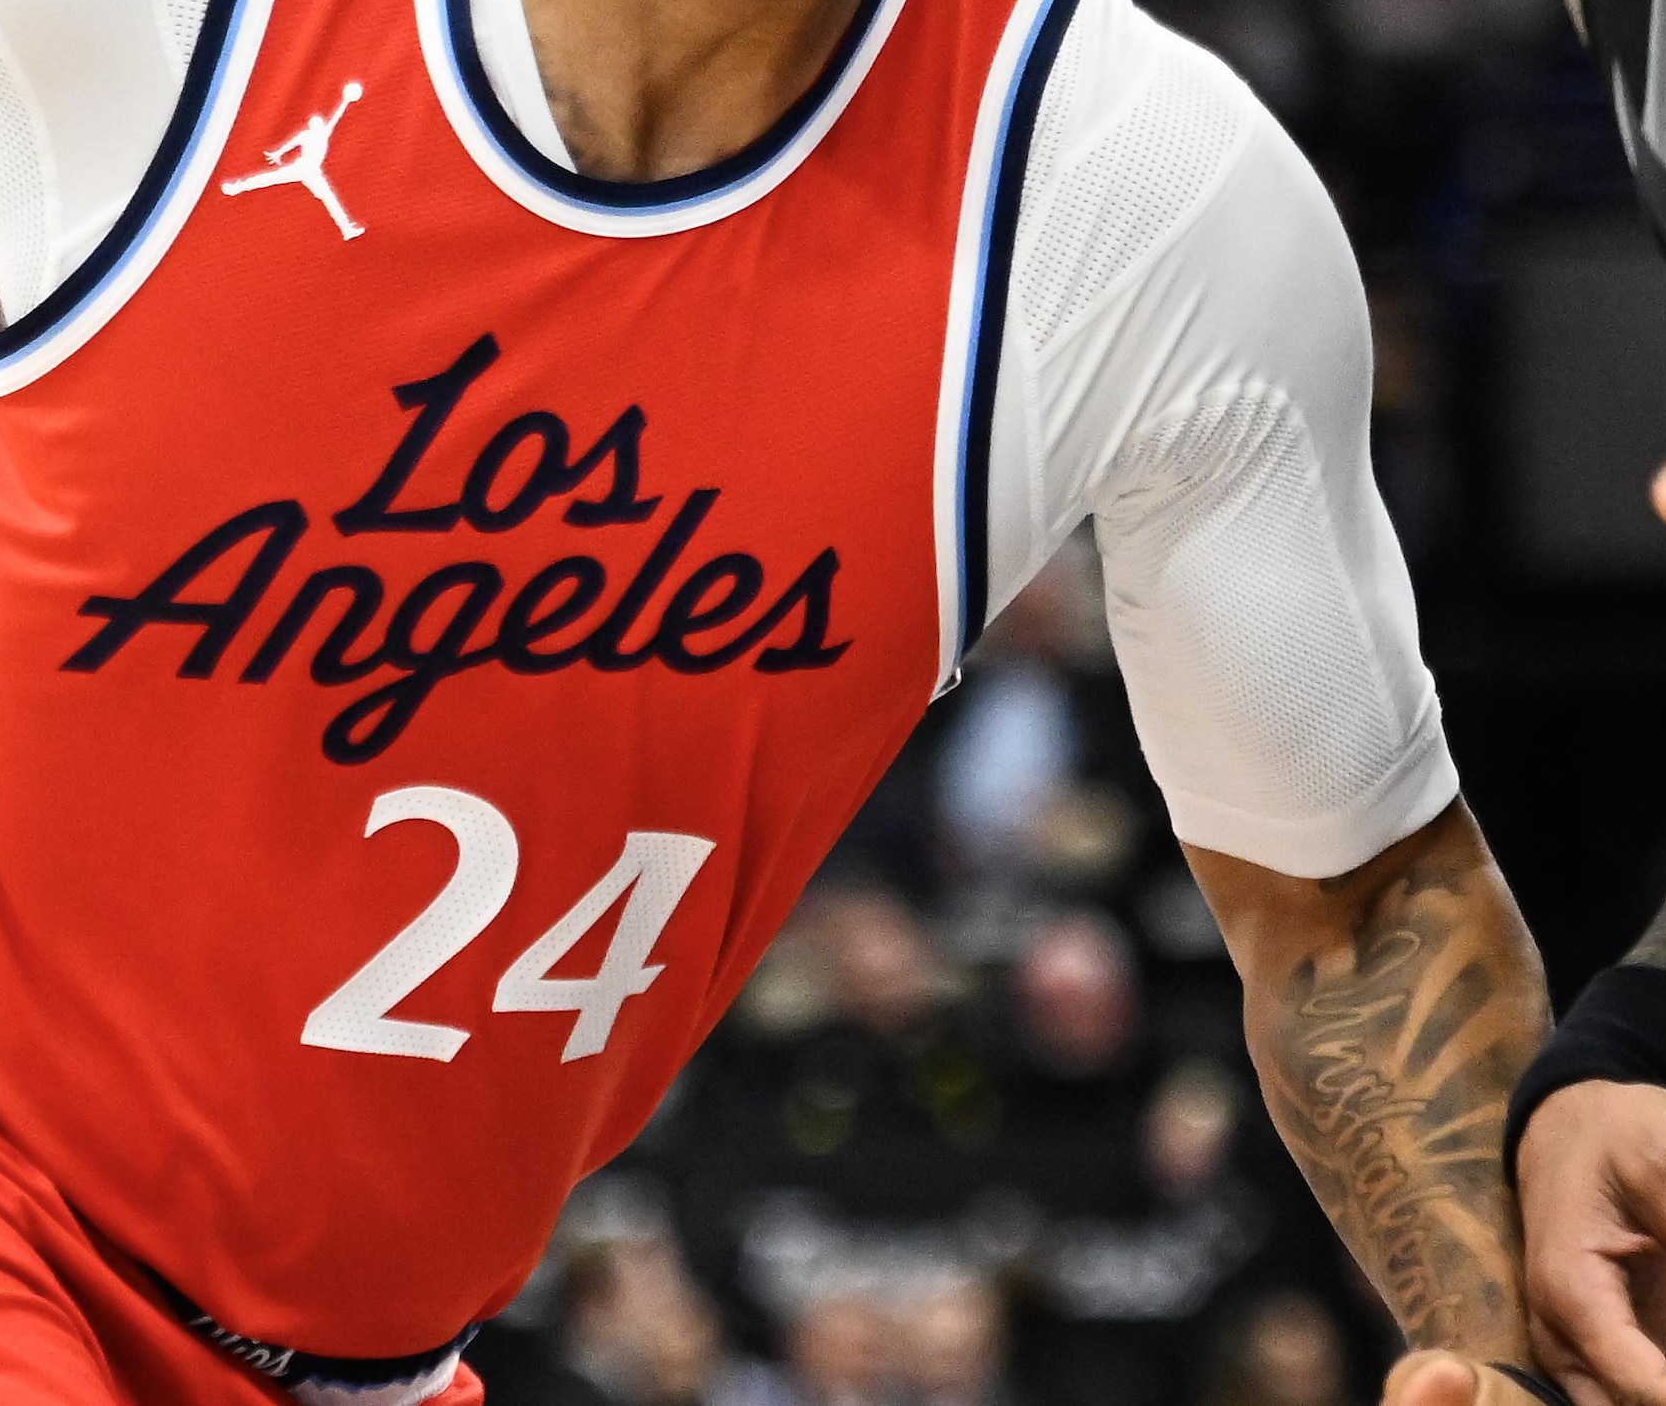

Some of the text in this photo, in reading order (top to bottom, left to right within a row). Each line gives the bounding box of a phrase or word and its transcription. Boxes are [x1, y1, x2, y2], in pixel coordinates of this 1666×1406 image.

[332, 331, 663, 538] Los
[58, 487, 855, 766] Angeles
[299, 784, 717, 1065] 24
